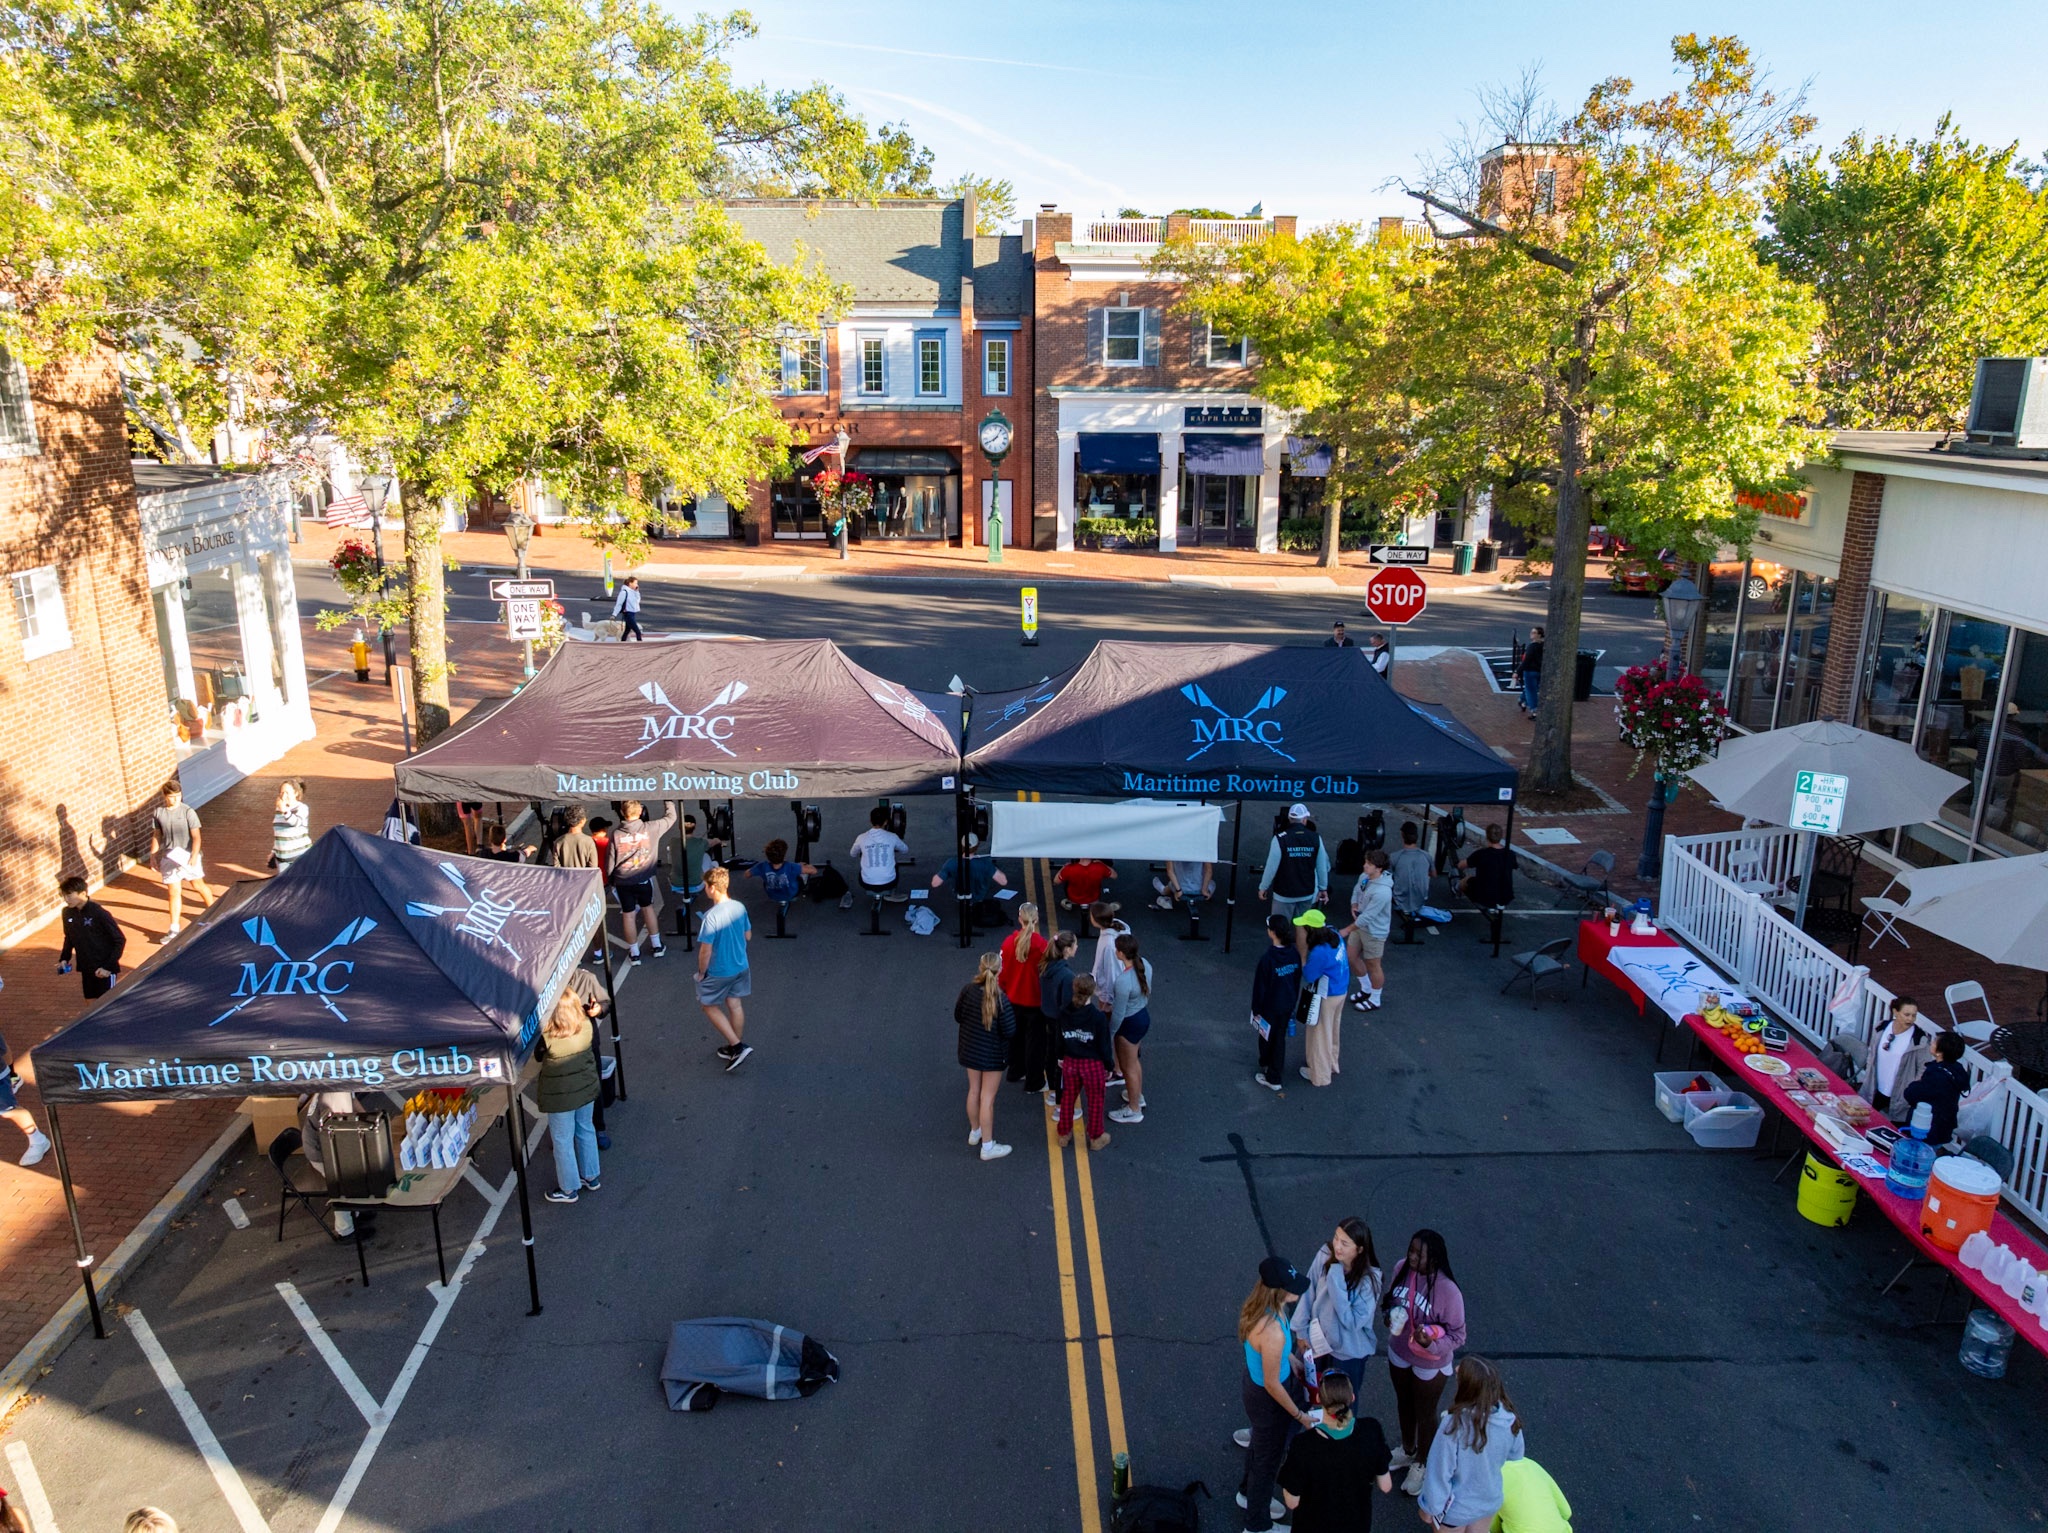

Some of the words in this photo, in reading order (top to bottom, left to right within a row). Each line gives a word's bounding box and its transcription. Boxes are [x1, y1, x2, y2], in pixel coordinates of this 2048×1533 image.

[790, 422, 859, 434] AYLOR
[145, 544, 182, 563] OONEY
[184, 542, 192, 557] &
[1387, 551, 1403, 559] ONE
[1406, 551, 1423, 559] WAY
[509, 586, 527, 594] ONE
[1370, 583, 1423, 606] STOP
[512, 603, 535, 613] ONE
[514, 614, 537, 623] WAY
[638, 715, 734, 740] MRC
[1191, 718, 1284, 744] MRC
[557, 773, 657, 793] Maritime
[662, 770, 744, 794] Rowing
[749, 770, 799, 790] Club
[1122, 772, 1220, 792] Maritime
[1226, 774, 1305, 798] Rowing
[1311, 776, 1359, 795] Club
[1799, 775, 1811, 790] 2
[1813, 784, 1843, 795] PARKING
[1815, 804, 1822, 812] TO
[1821, 814, 1830, 822] PM
[456, 888, 516, 945] MRC
[583, 893, 602, 934] Club
[230, 959, 355, 997] MRC
[1646, 962, 1699, 994] MRC
[74, 1057, 240, 1091] Maritime
[247, 1052, 383, 1084] Rowing
[391, 1046, 473, 1077] Club
